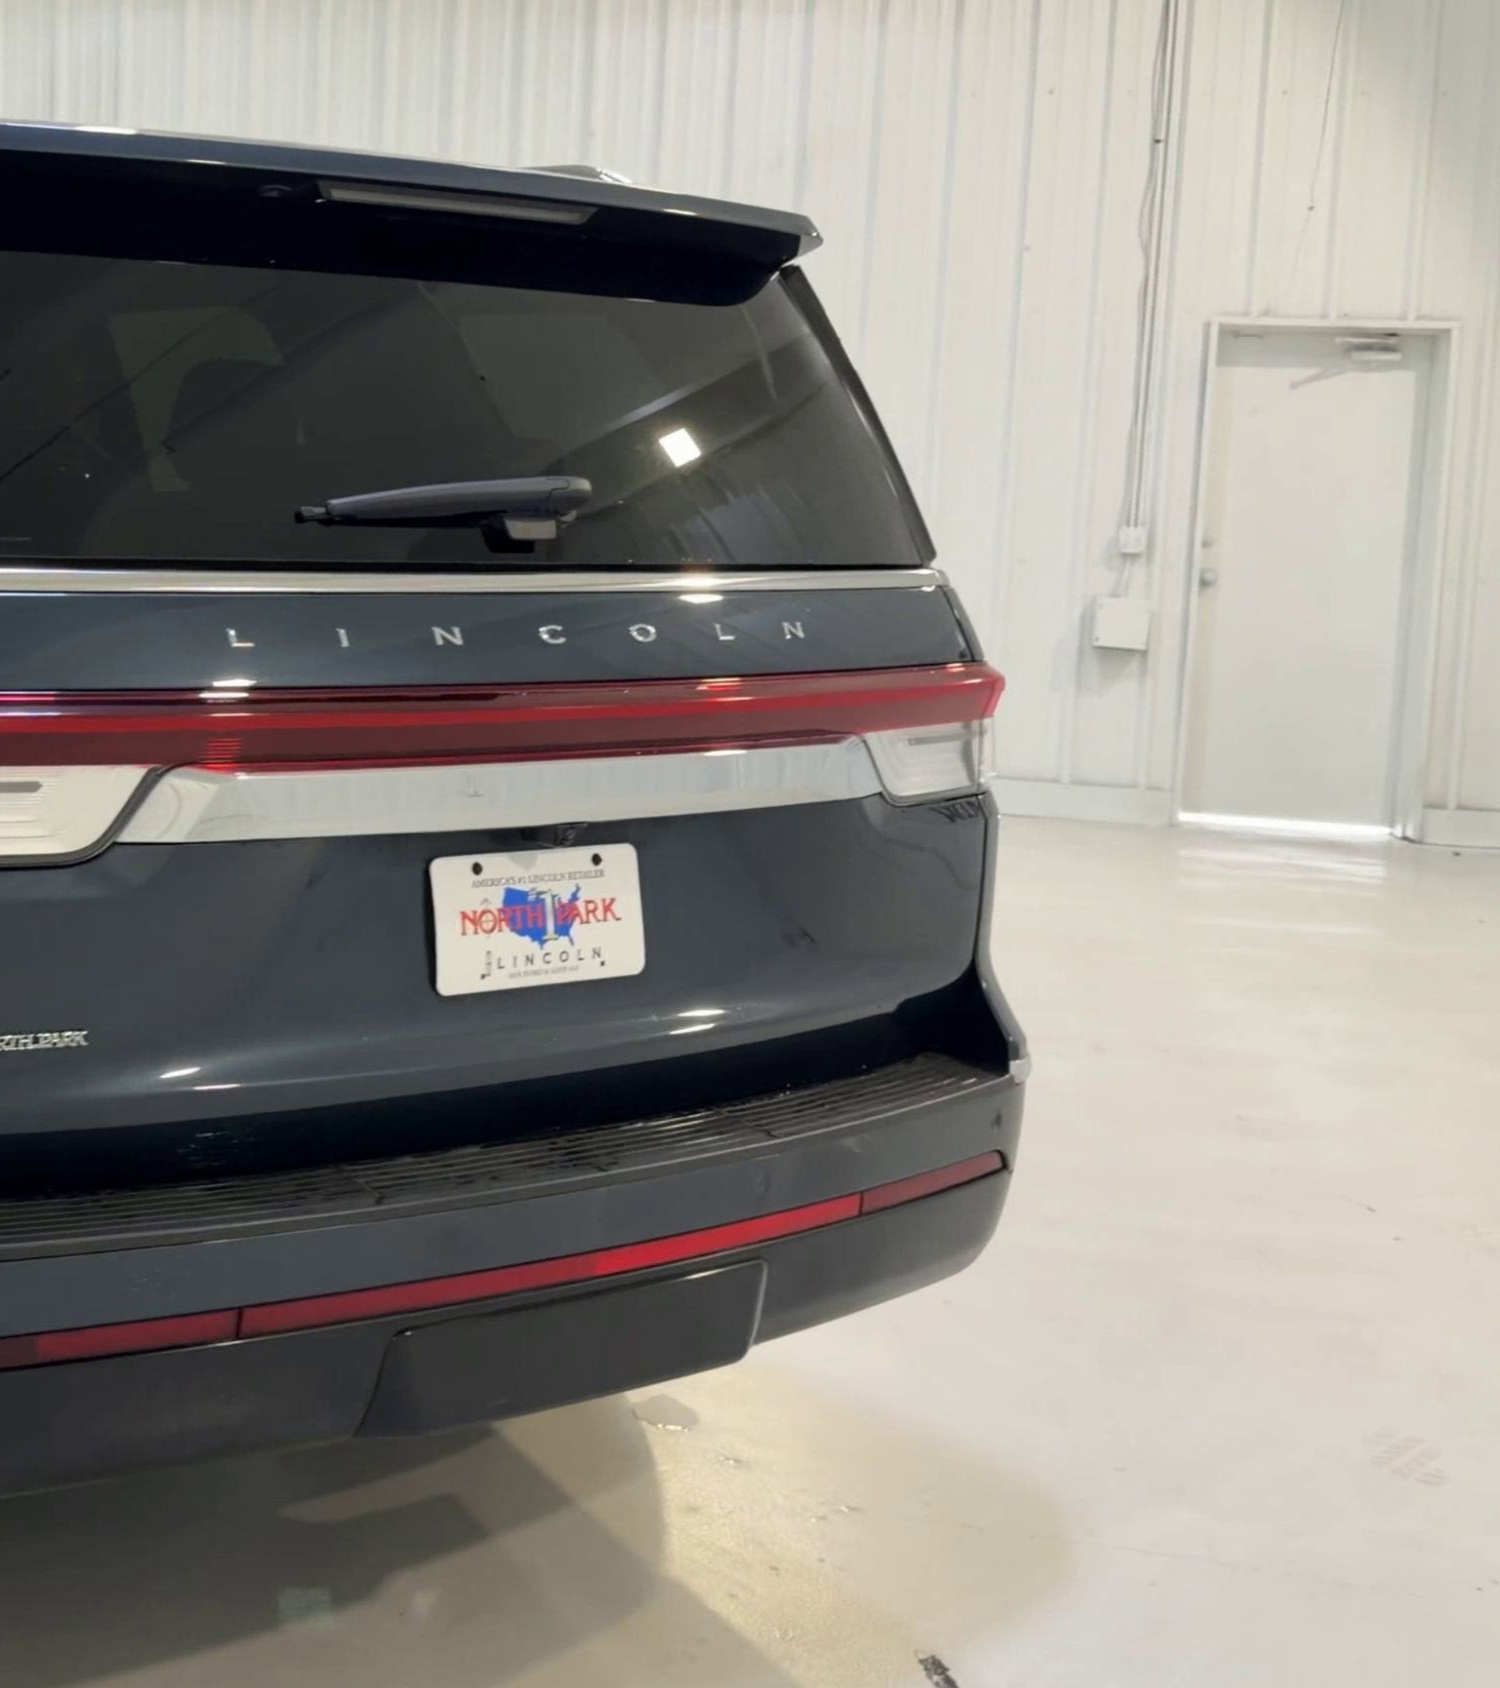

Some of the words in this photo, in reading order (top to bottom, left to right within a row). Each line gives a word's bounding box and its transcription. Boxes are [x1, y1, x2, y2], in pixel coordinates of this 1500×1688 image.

[225, 621, 805, 648] LINCOLN
[460, 902, 546, 936] NORTH
[555, 898, 621, 927] PARK
[497, 946, 601, 969] LINCOLN
[36, 1030, 89, 1049] PARK
